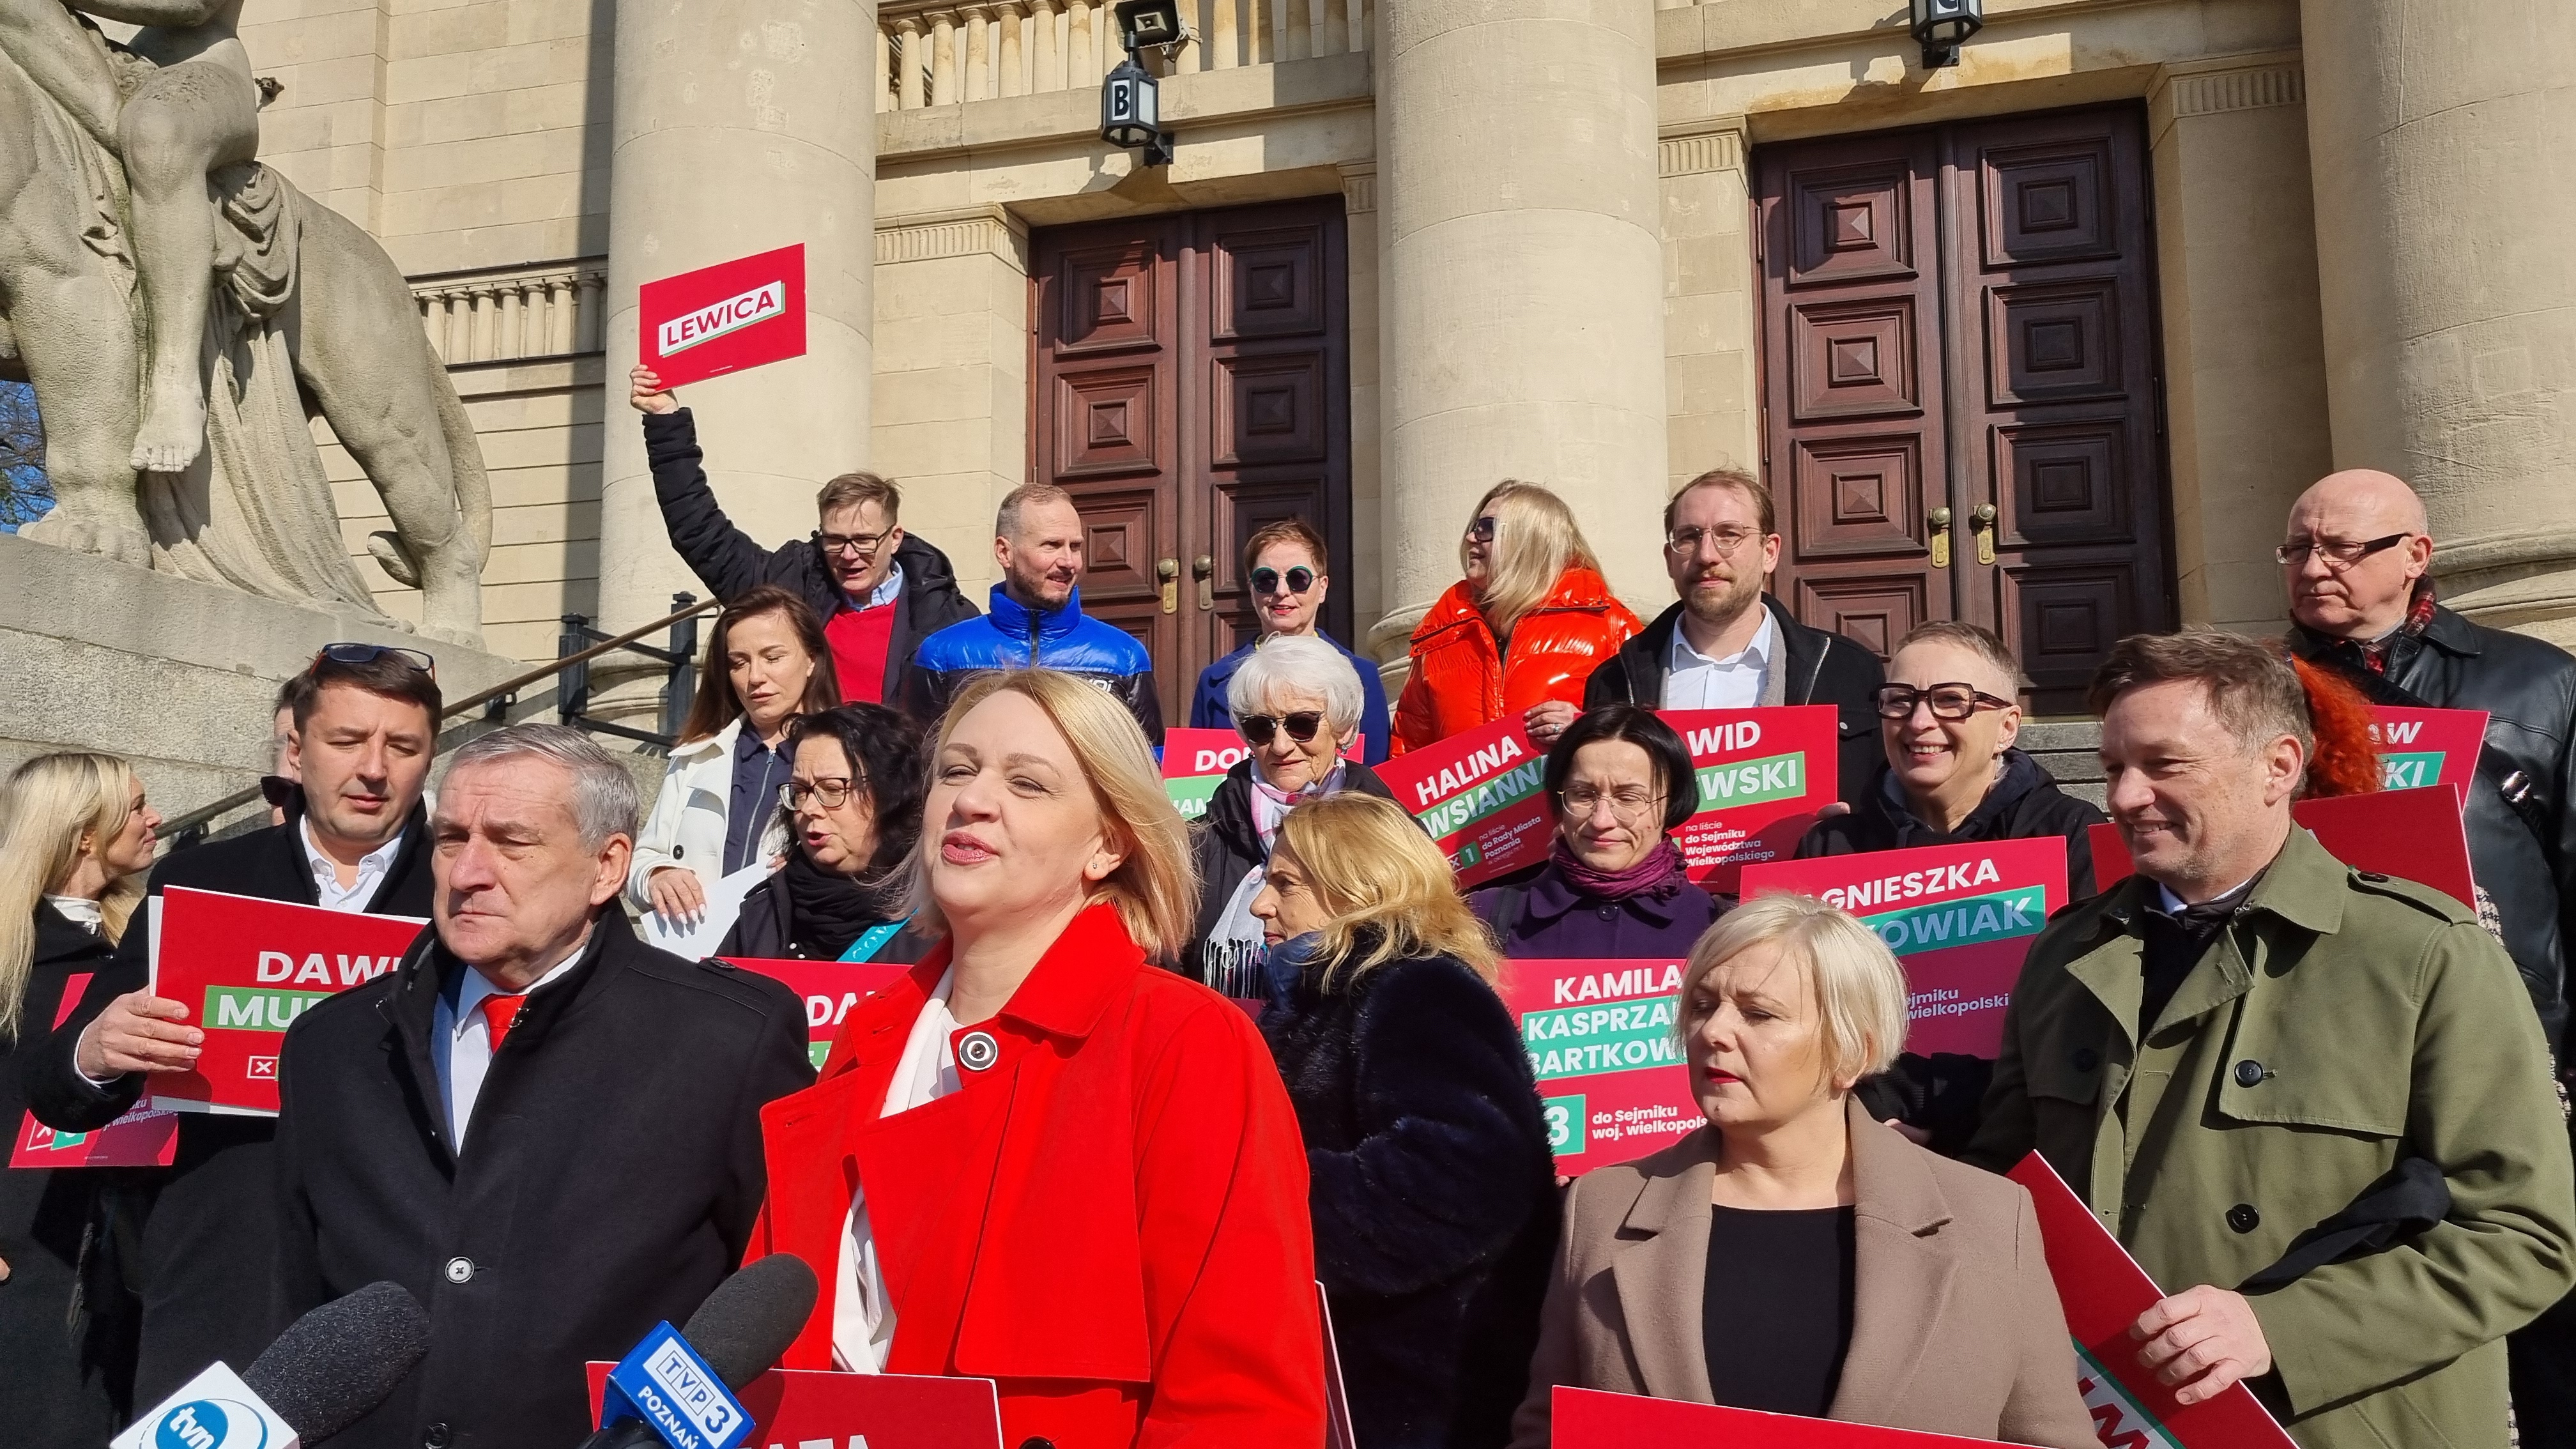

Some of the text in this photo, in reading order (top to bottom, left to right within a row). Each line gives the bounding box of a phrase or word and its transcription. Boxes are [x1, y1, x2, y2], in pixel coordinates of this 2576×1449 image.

[1114, 84, 1129, 116] B
[667, 290, 775, 347] LEWICA
[1686, 720, 1761, 756] WID
[1415, 735, 1523, 806] HALINA
[1696, 759, 1797, 801] WSKI
[2378, 761, 2425, 787] KI
[1478, 832, 1489, 841] na
[1482, 816, 1542, 850] do Rady Miasta
[1685, 820, 1723, 832] na liście
[1685, 829, 1746, 844] do Sejmiku
[1466, 848, 1475, 862] 1
[1484, 837, 1521, 859] Poznania
[1685, 839, 1761, 856] Województwa
[1685, 850, 1775, 867] Wielkopolskiego
[1804, 858, 2000, 910] GNIESZKA
[1866, 897, 2033, 950] OWIAK
[1554, 964, 1683, 1004] KAMILA
[1528, 1036, 1687, 1075] BARTKOW
[1544, 1105, 1570, 1146] 3
[1592, 1105, 1678, 1125] do Sejmiku
[1591, 1124, 1623, 1141] woj.
[169, 1406, 215, 1449] tvn
[638, 1385, 700, 1449] POZNAŃ
